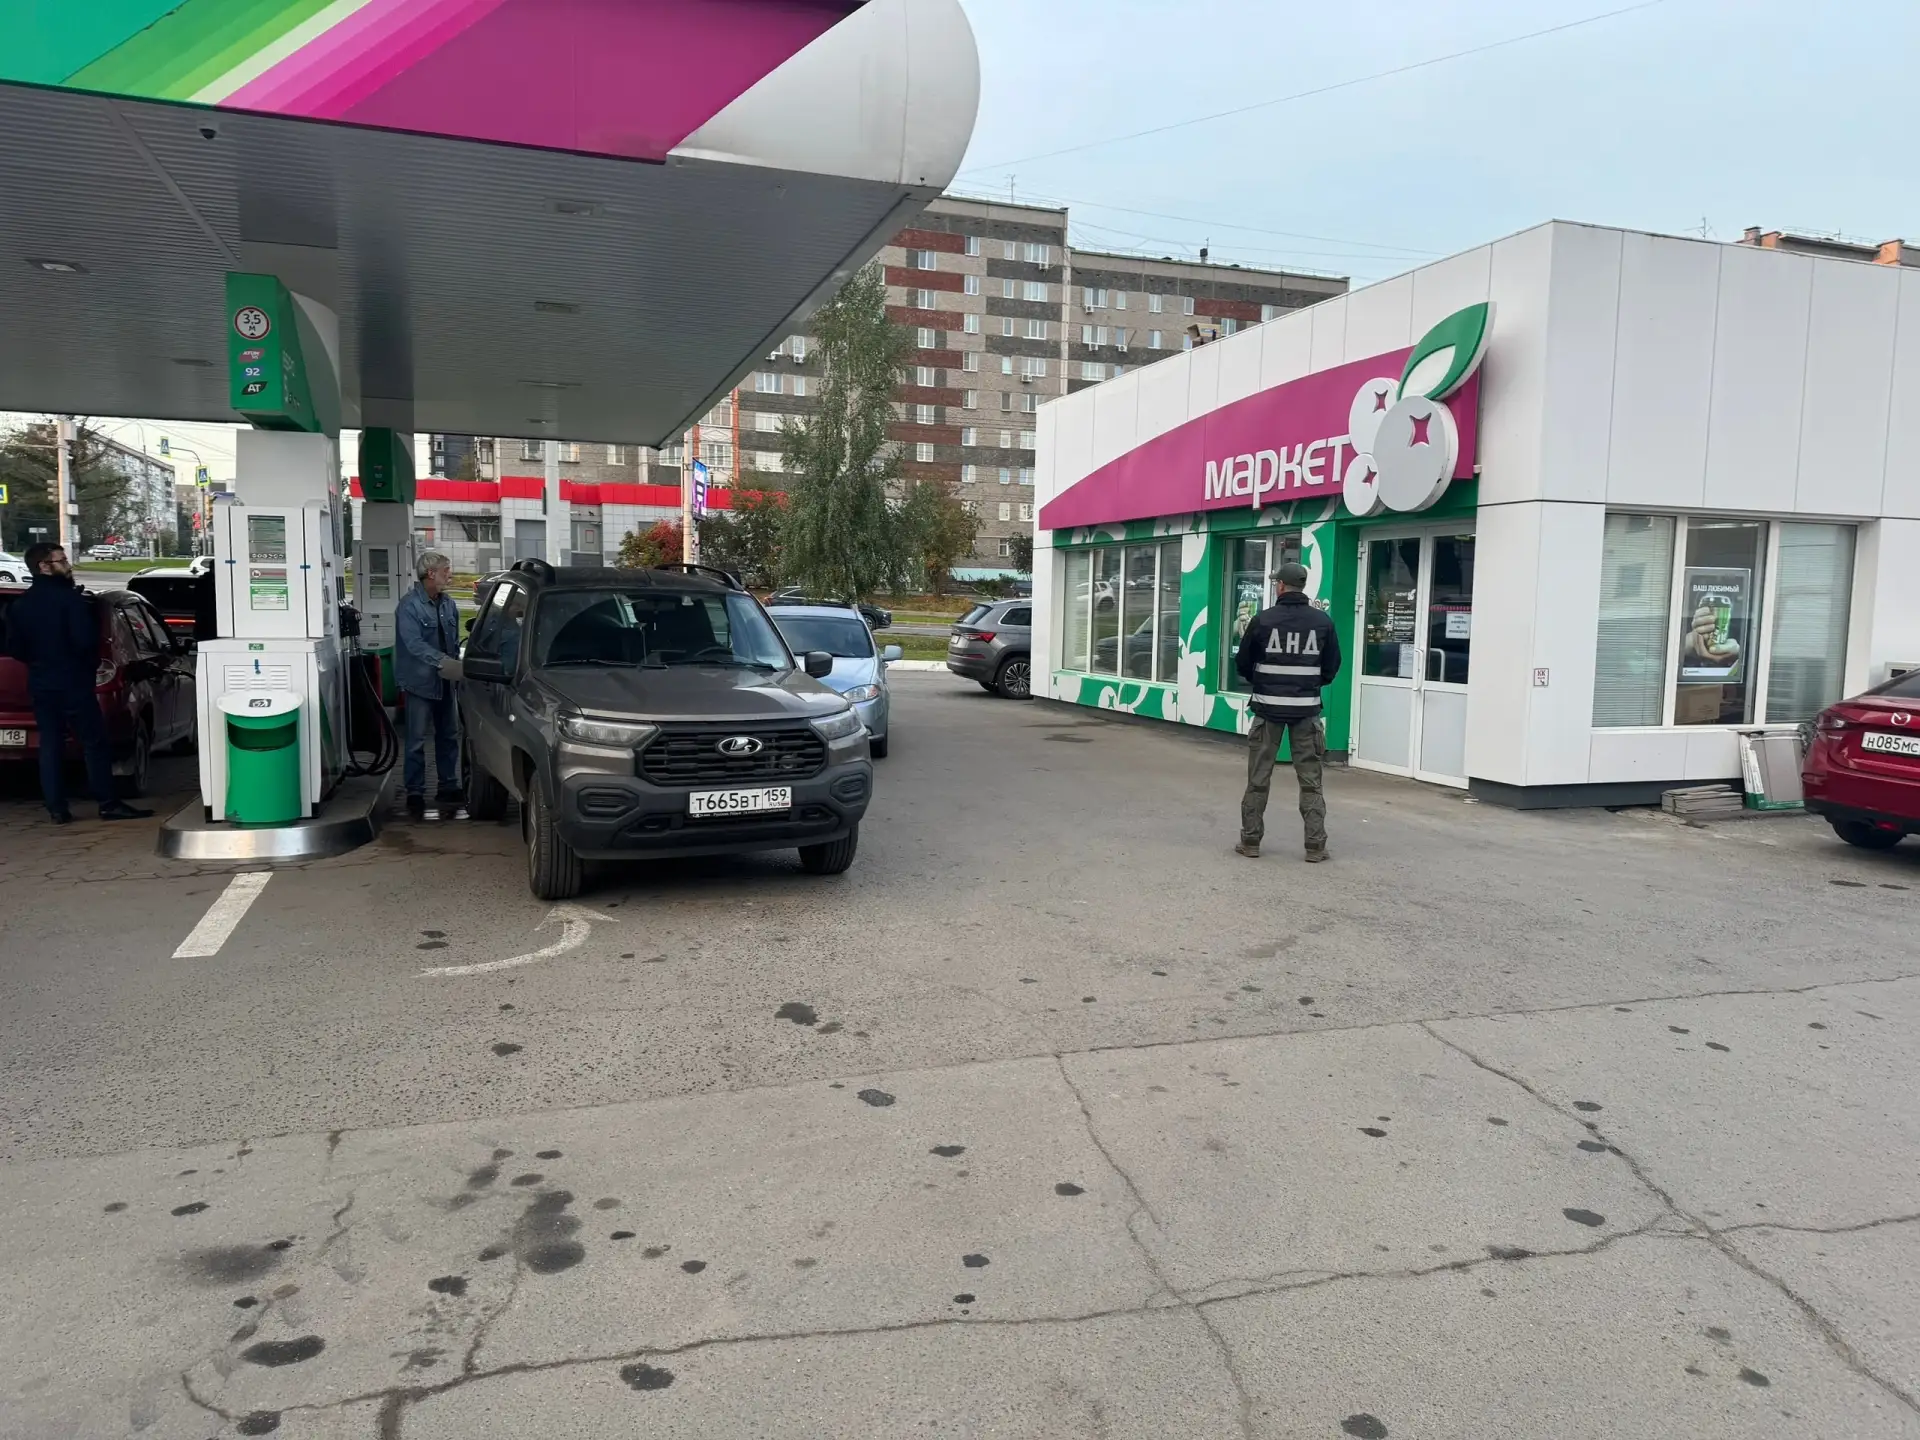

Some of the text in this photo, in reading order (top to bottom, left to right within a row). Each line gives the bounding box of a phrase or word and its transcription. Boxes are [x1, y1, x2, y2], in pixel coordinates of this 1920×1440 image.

[245, 367, 260, 376] 92
[1692, 584, 1740, 593] ВАШ ЛЮБИМЫЙ
[1265, 628, 1320, 655] ДНД
[6, 731, 20, 740] 18
[1866, 735, 1919, 753] Н085МС
[695, 789, 787, 811] Т665ВТ 159
